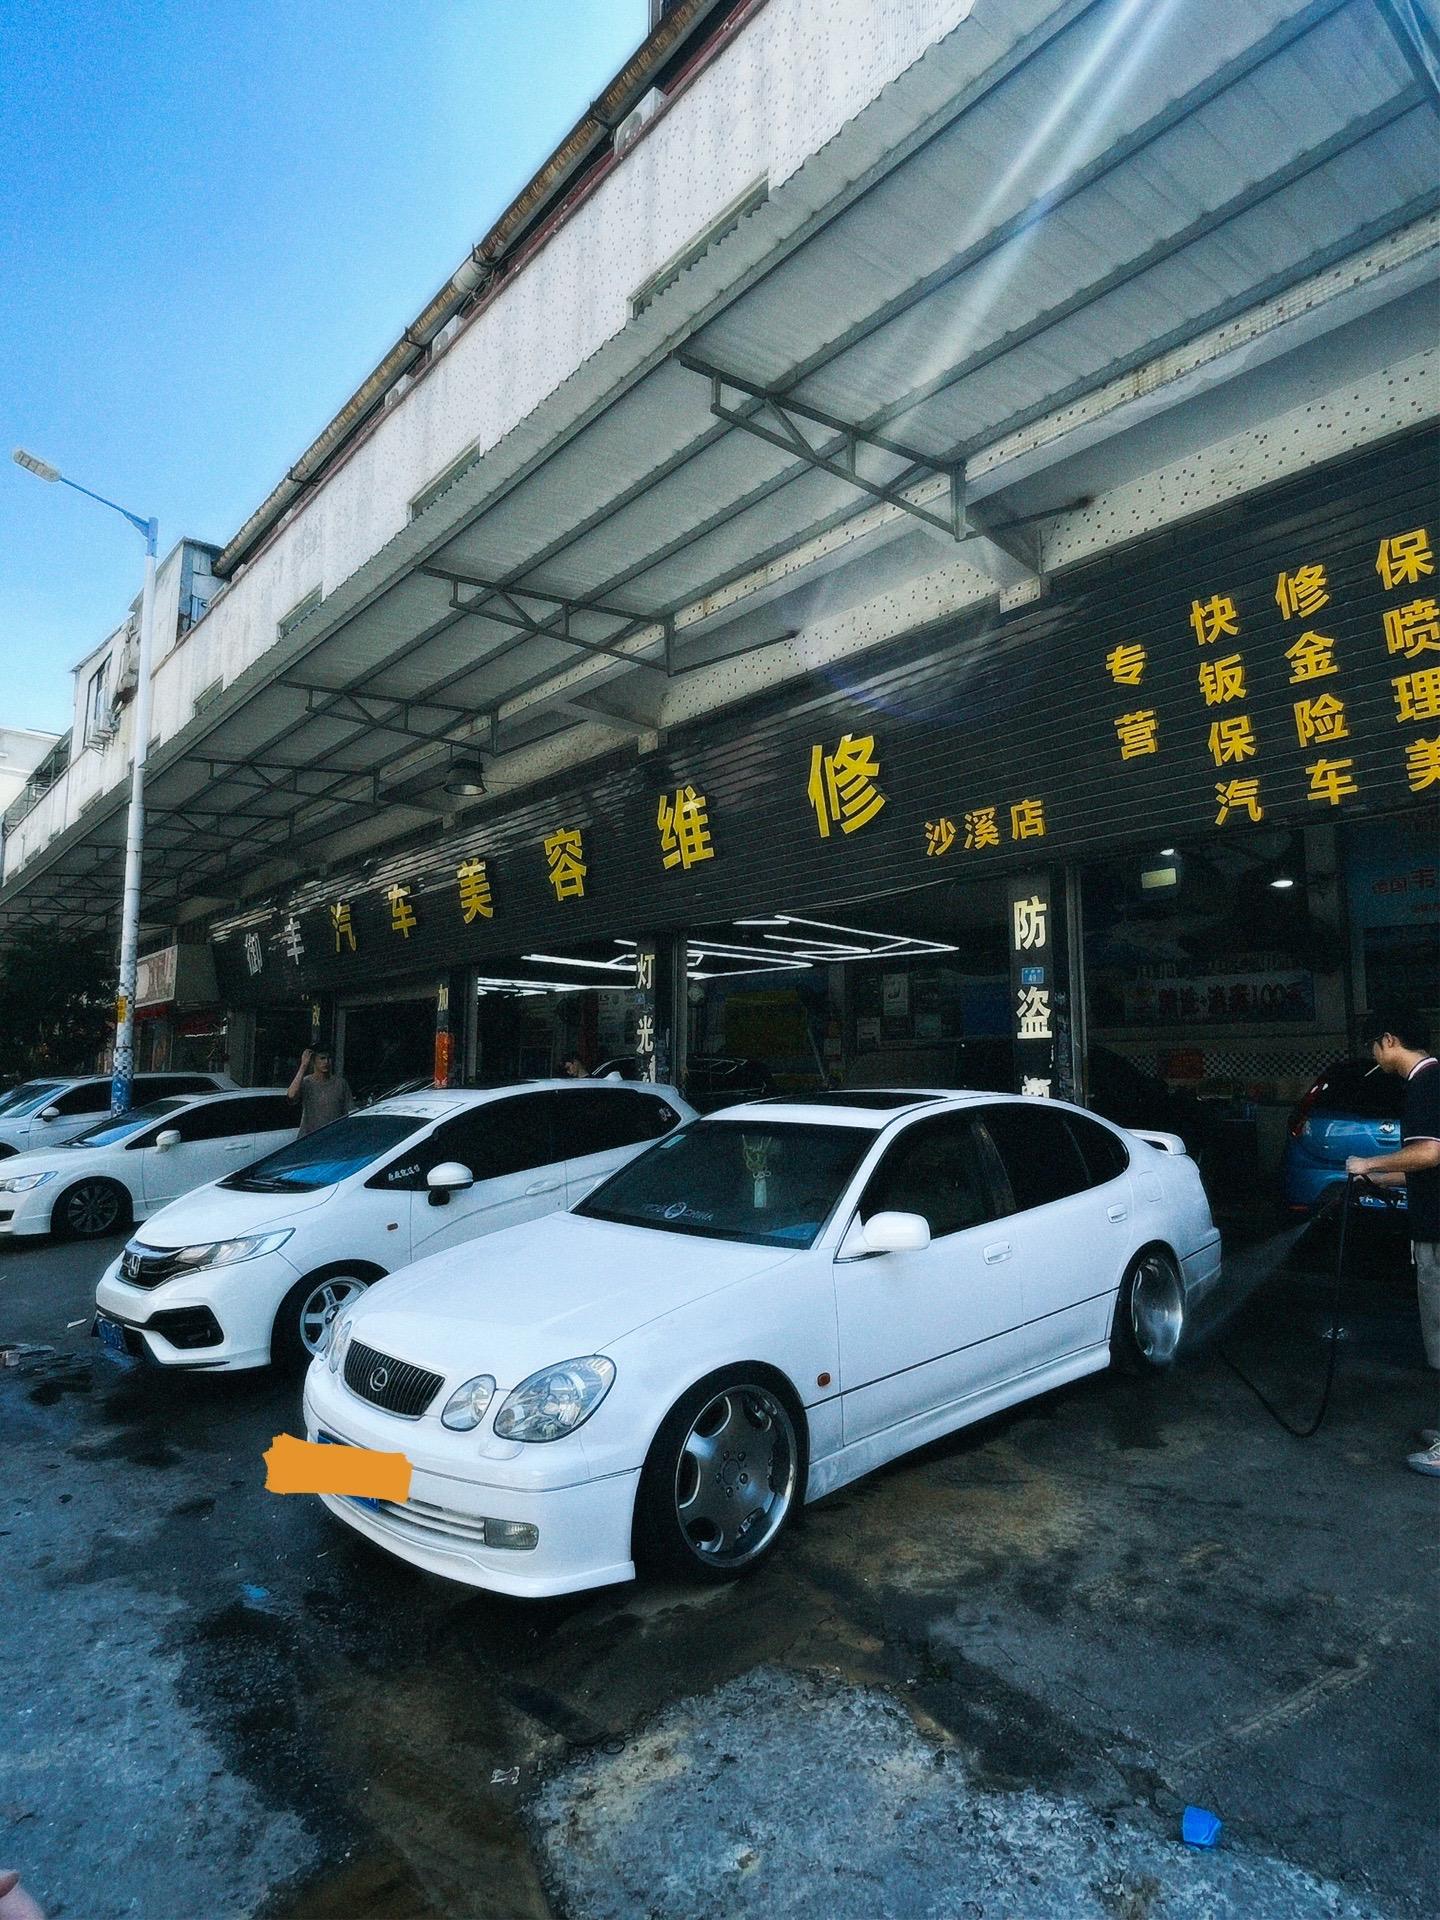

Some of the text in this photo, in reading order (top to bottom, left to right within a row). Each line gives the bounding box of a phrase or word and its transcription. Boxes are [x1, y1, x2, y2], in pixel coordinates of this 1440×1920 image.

[1105, 643, 1159, 761] 专营
[924, 799, 1047, 857] 沙溪店
